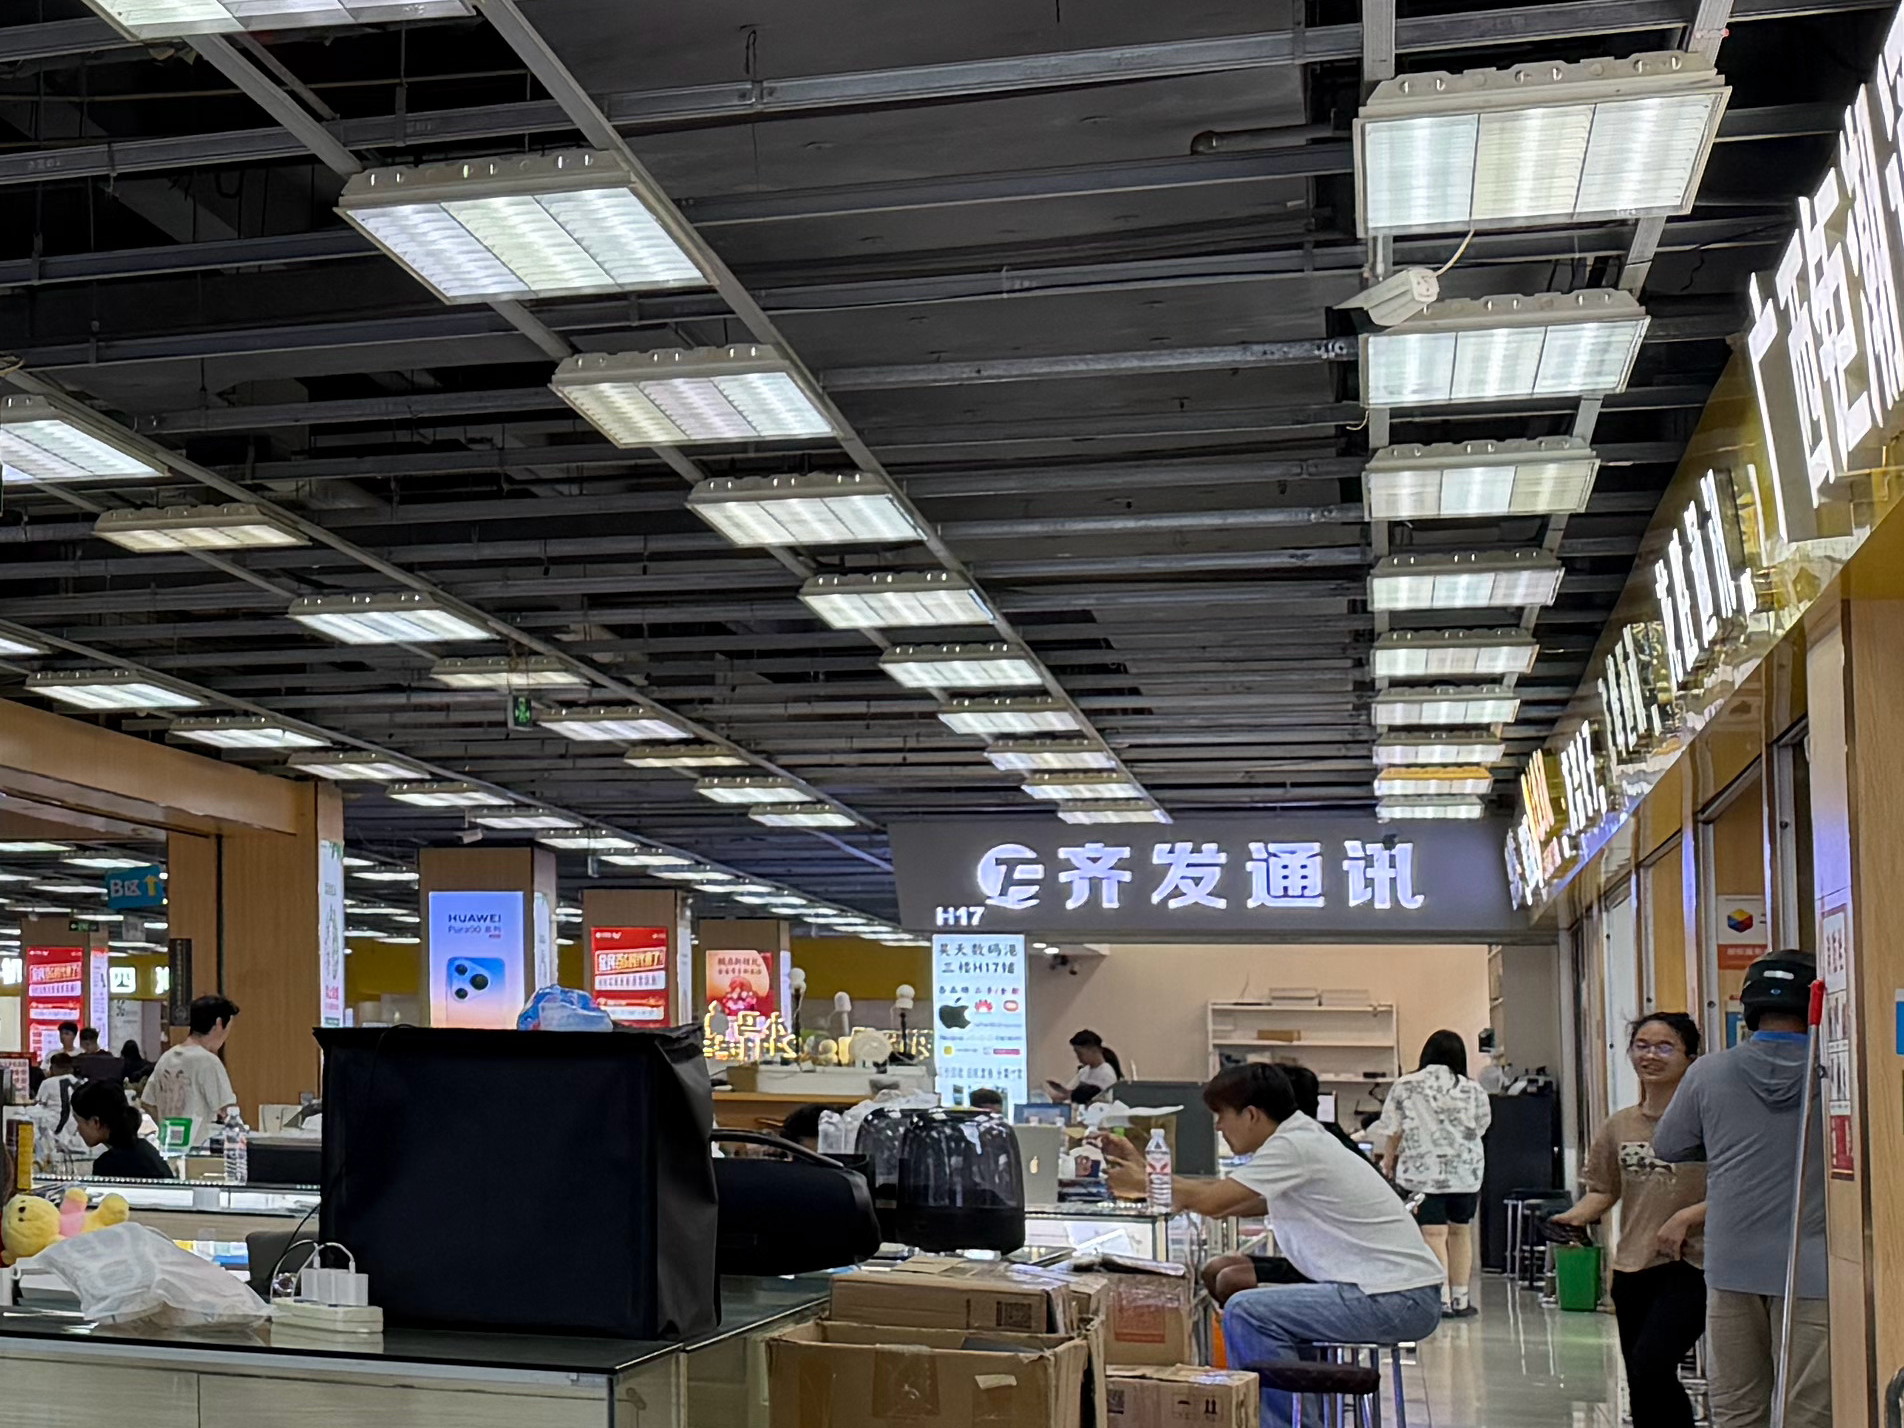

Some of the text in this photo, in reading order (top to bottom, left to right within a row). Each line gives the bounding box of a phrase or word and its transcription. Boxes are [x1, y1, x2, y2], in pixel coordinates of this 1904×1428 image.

[1058, 840, 1425, 910] 齐发通讯
[110, 880, 140, 897] B区
[448, 914, 501, 923] HUAWEI
[936, 906, 985, 926] H17
